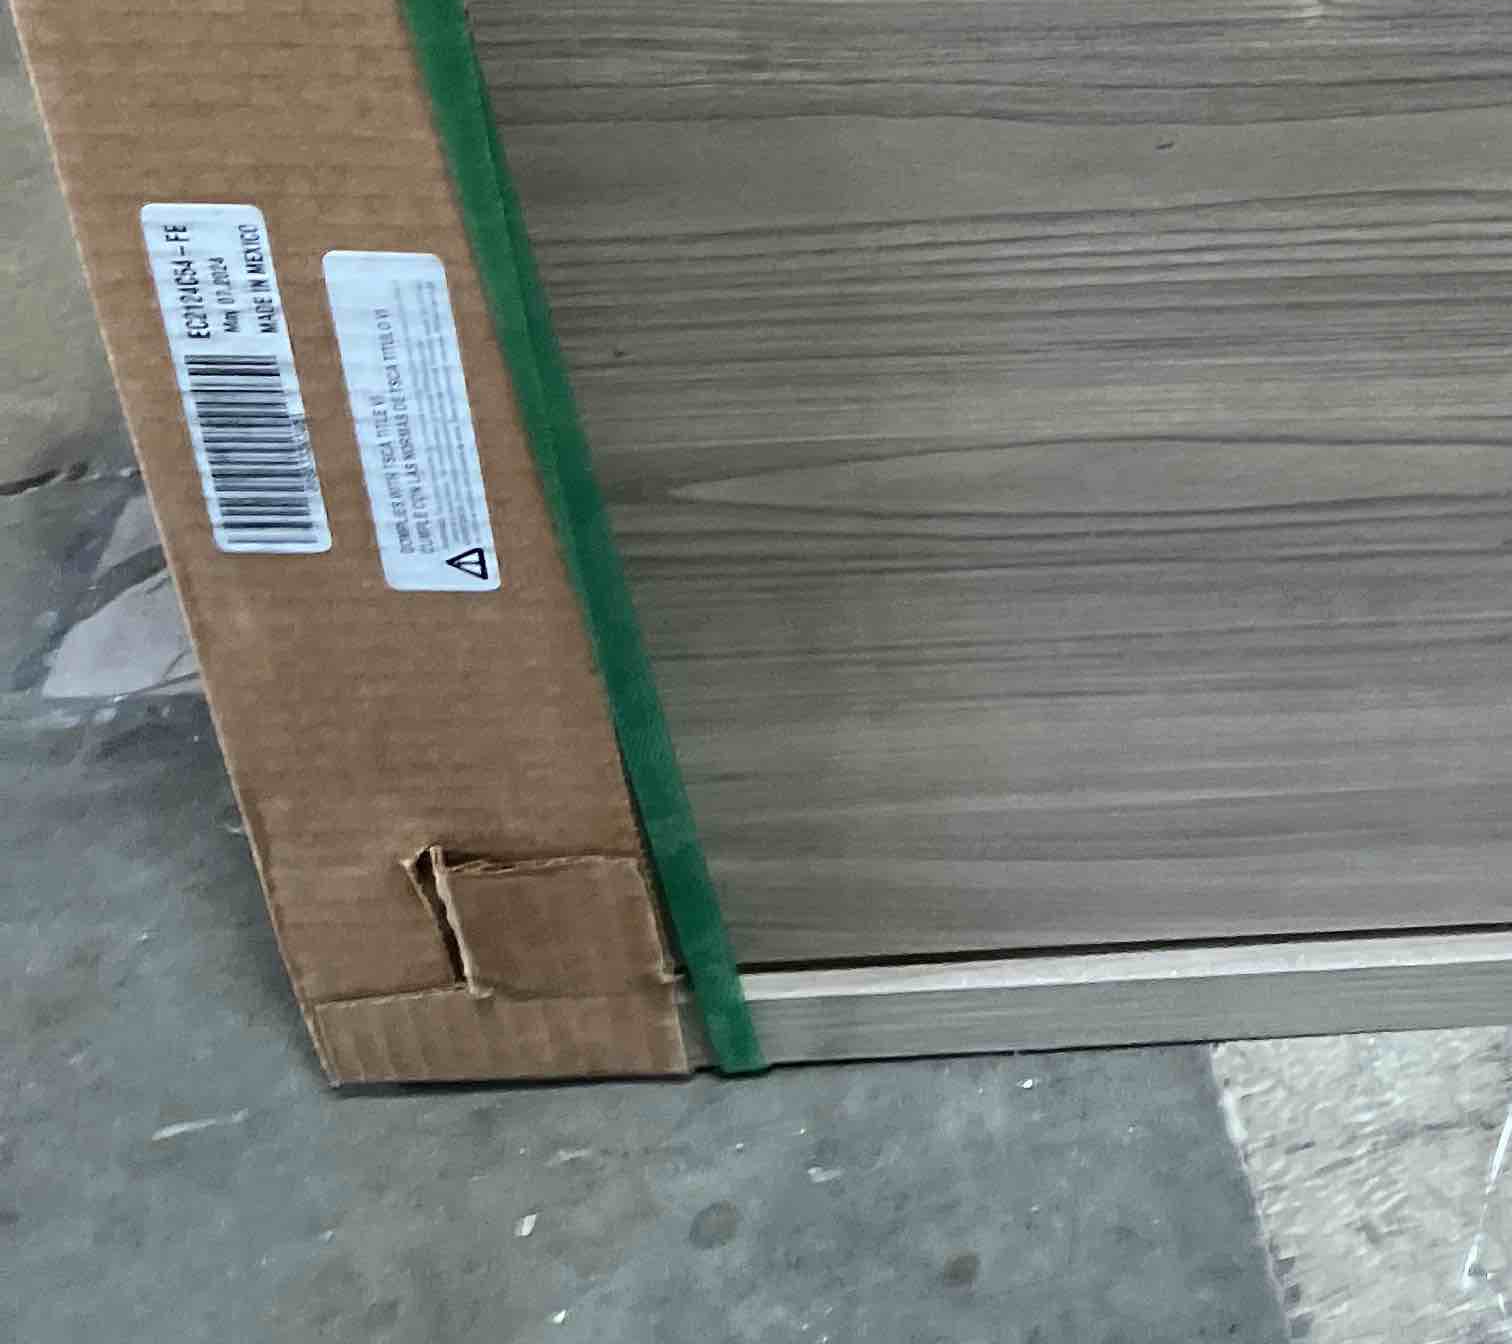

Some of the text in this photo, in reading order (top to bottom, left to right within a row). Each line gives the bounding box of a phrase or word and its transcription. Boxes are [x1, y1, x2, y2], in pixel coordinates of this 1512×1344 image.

[237, 223, 280, 334] MADE IN MEXICO
